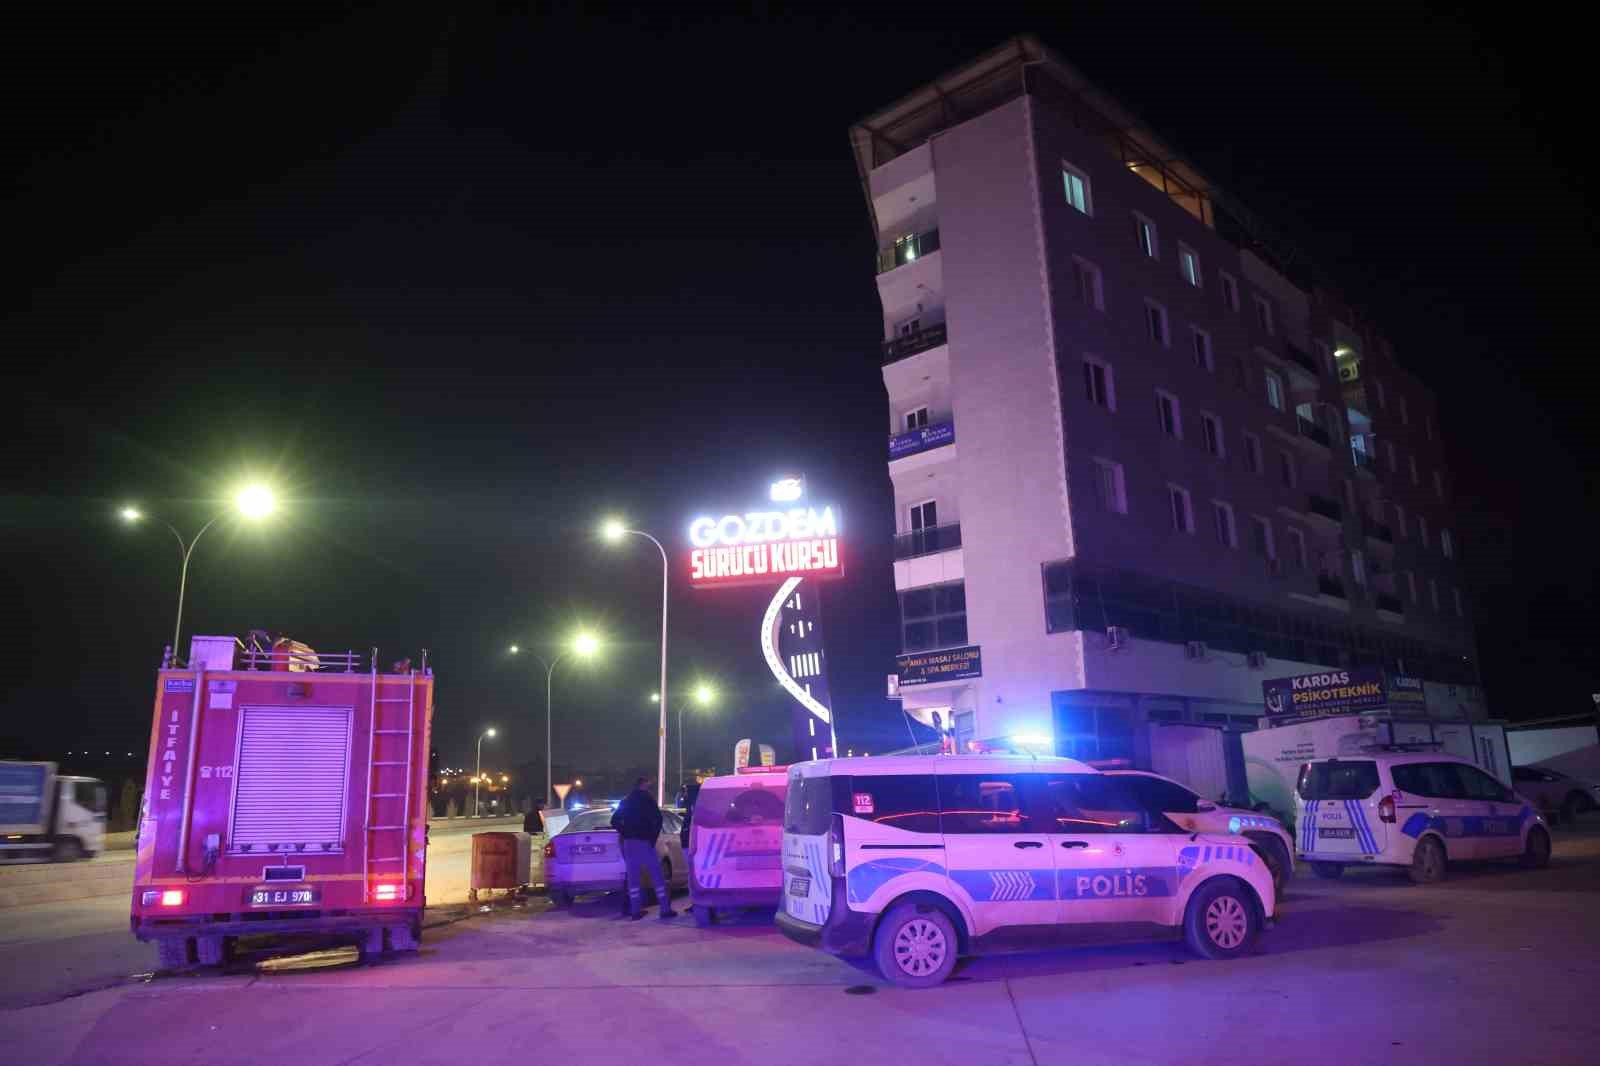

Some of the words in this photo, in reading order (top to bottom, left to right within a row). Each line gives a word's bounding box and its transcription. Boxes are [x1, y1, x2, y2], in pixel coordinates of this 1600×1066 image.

[771, 538, 838, 573] KURSU
[1291, 671, 1350, 690] KARDAŞ
[1292, 682, 1383, 705] PSİKOTEKNİK
[215, 766, 233, 778] 112
[856, 795, 871, 805] 112
[1076, 868, 1148, 897] POLİS
[256, 891, 268, 903] 31
[274, 891, 288, 902] EJ
[292, 890, 310, 902] 970
